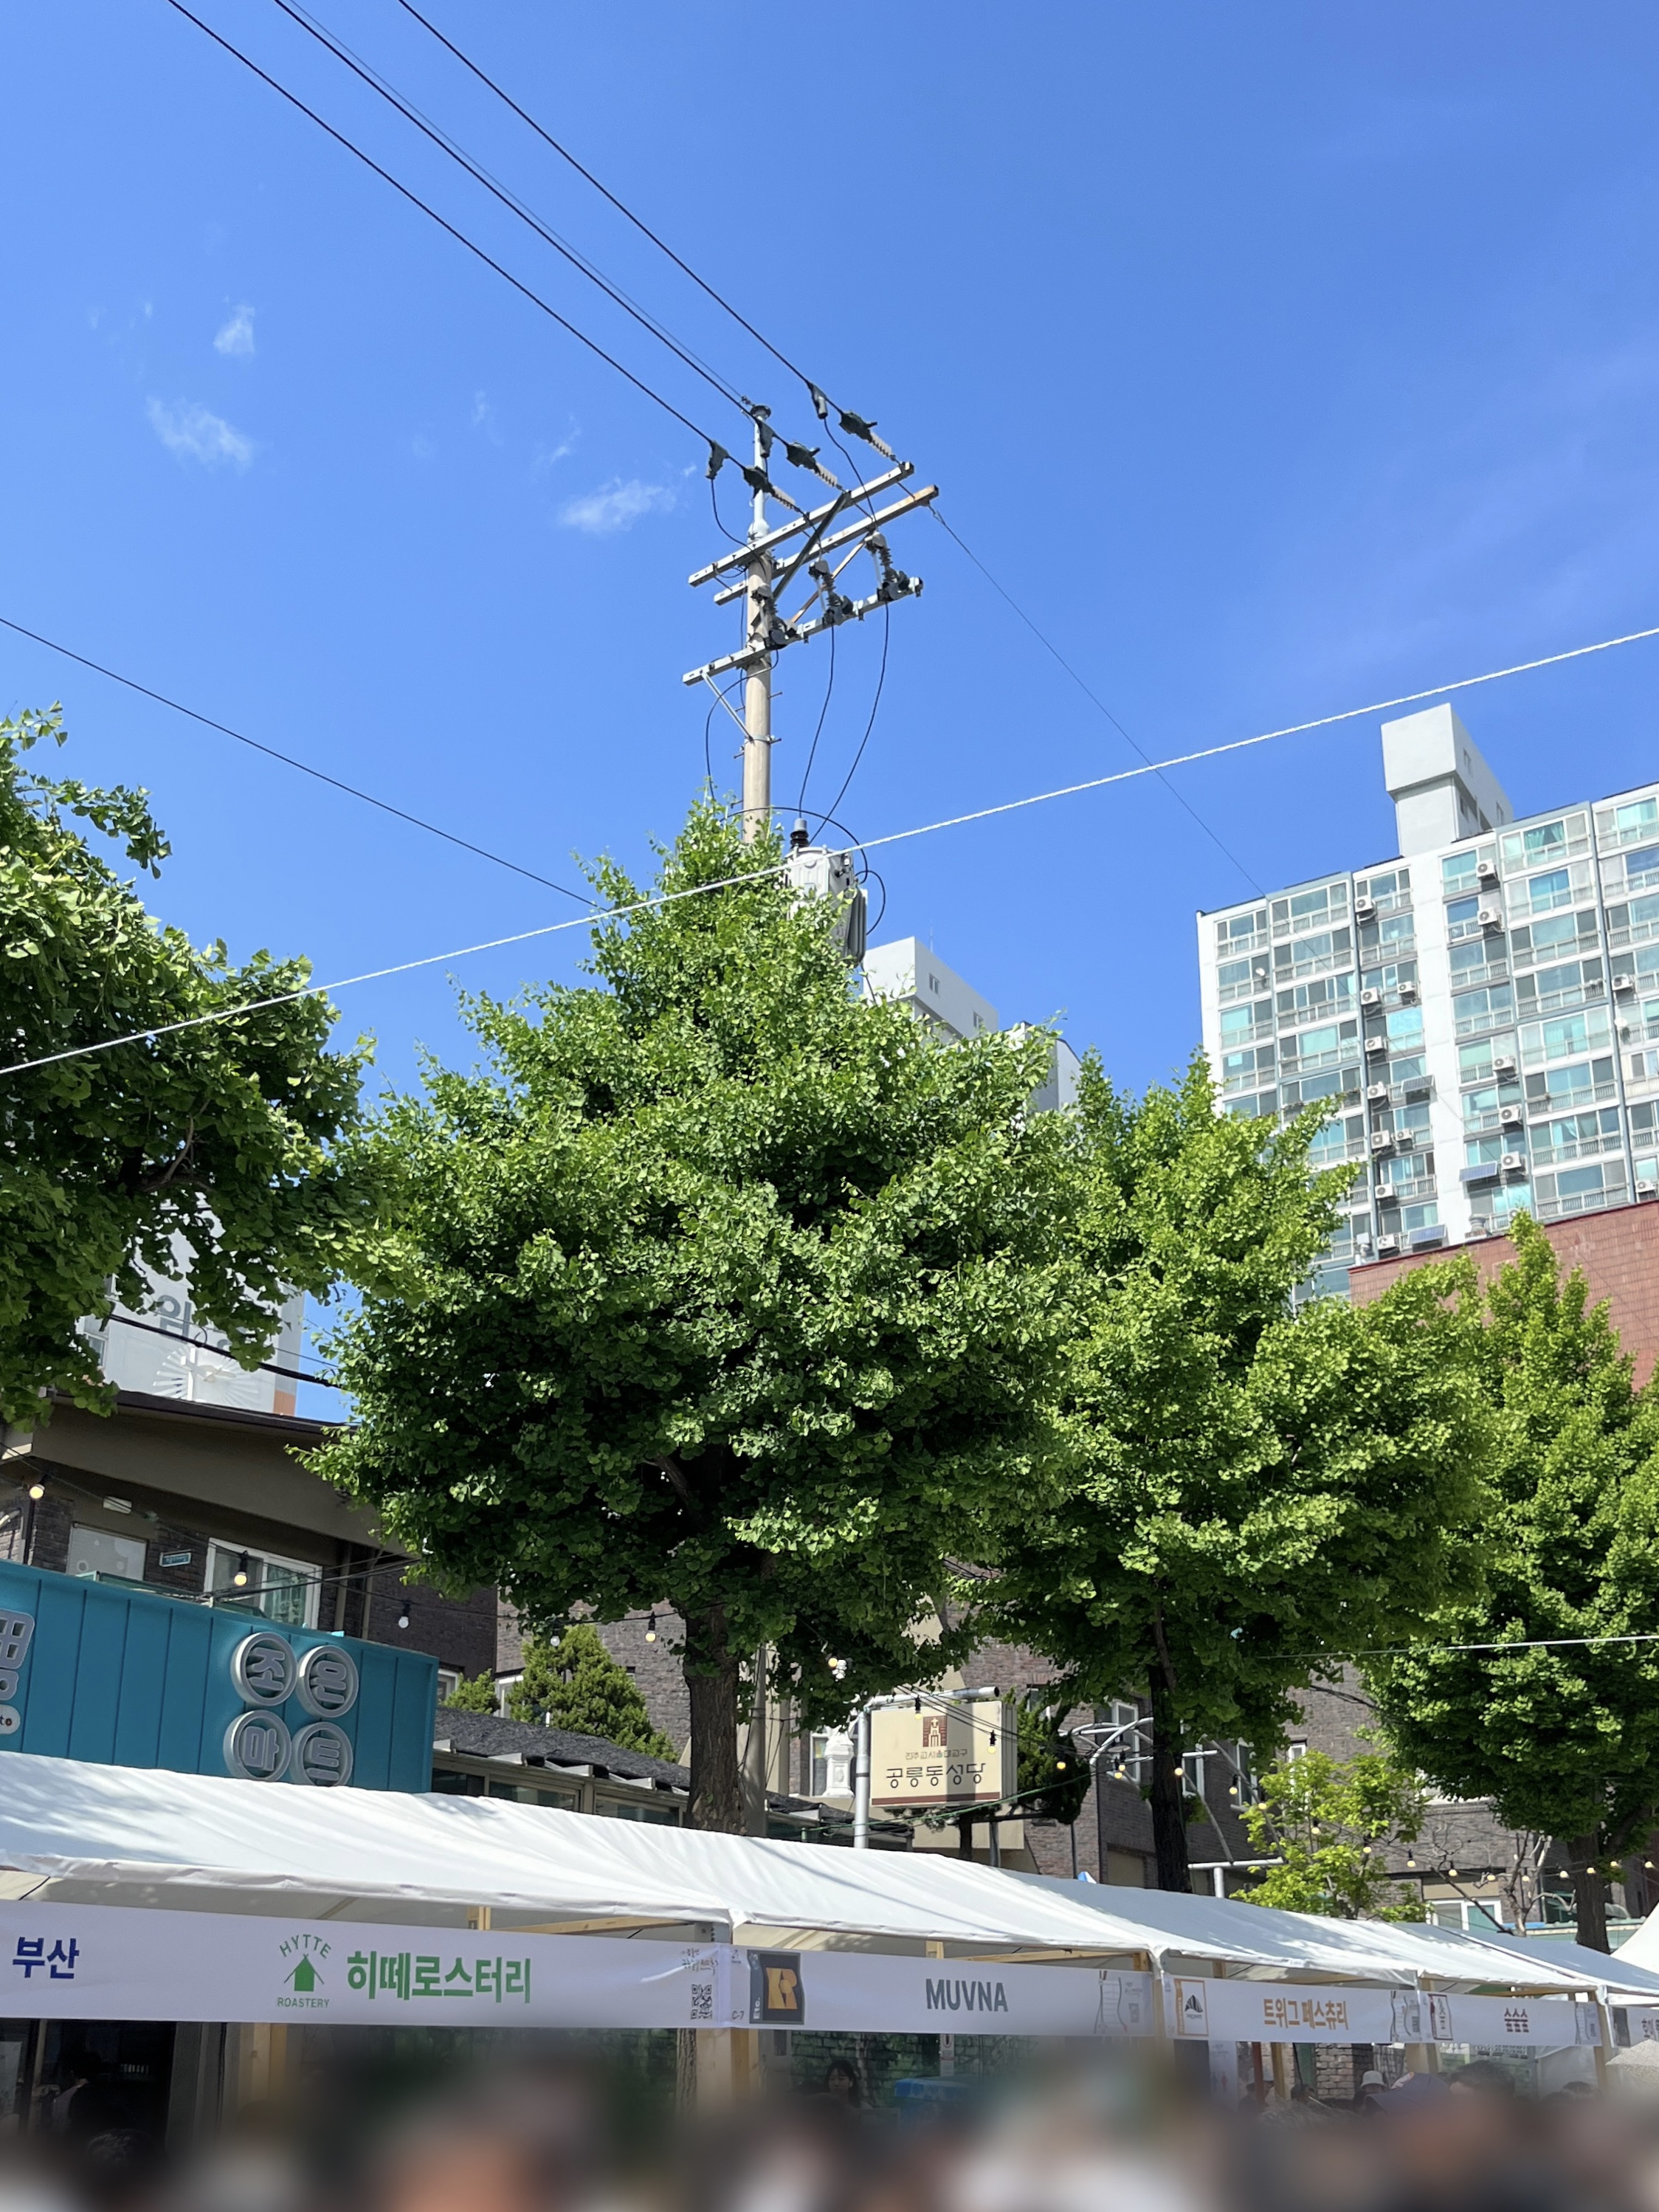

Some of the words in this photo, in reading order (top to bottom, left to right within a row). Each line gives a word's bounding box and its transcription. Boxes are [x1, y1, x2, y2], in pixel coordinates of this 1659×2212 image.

[886, 1763, 986, 1789] 공릉동성당
[12, 1937, 80, 1979] 부산
[279, 1934, 332, 1960] HYTTE
[347, 1951, 531, 2004] 히떼로스터리
[277, 1996, 330, 2008] ROASTERY
[925, 1979, 1008, 2012] MUVNA
